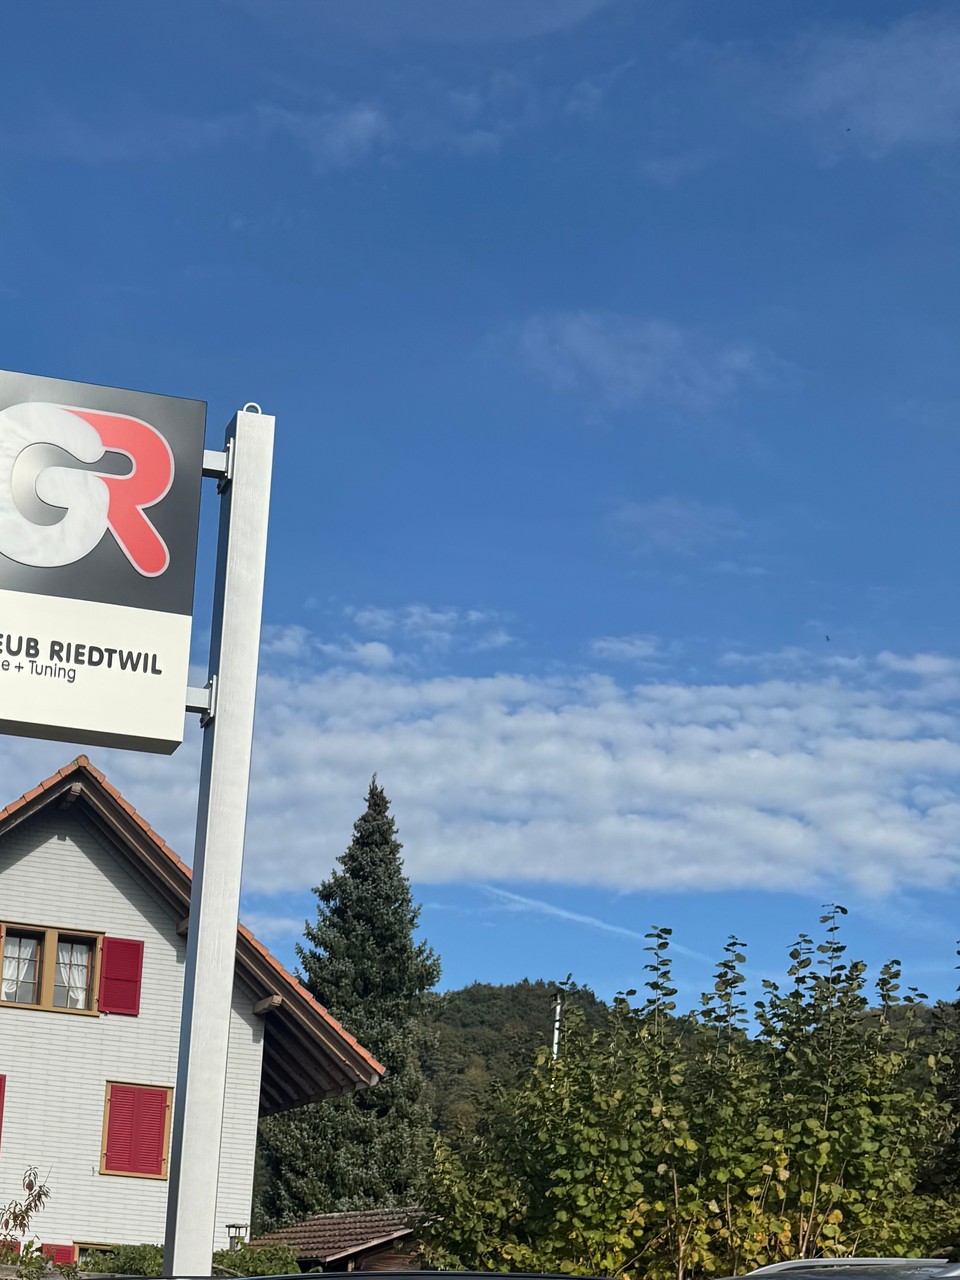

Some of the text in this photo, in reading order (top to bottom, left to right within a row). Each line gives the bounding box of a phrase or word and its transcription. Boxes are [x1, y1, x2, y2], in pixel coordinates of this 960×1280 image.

[14, 662, 25, 673] +
[28, 660, 77, 683] Tuning
[48, 640, 163, 675] RIEDTWIL
